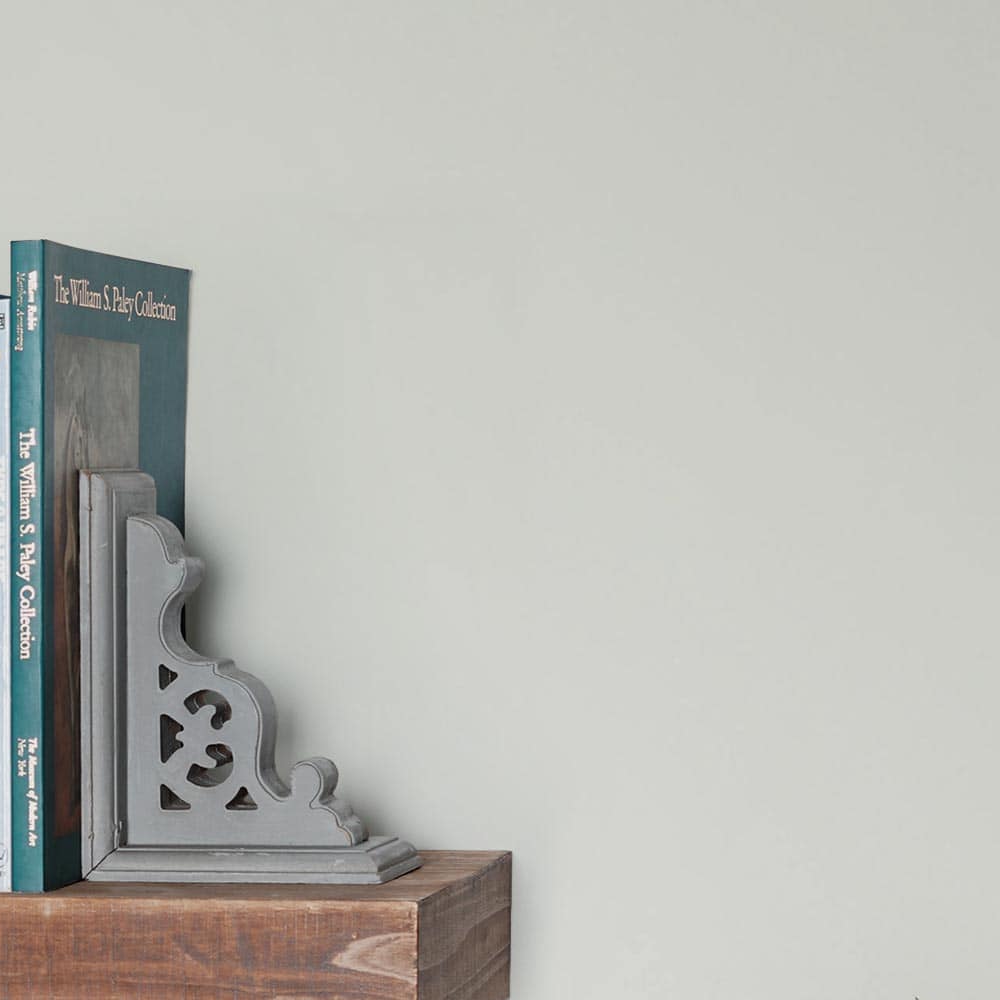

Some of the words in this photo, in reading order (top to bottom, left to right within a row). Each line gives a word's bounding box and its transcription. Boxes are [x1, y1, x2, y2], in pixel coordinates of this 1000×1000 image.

[53, 274, 69, 304] The
[69, 278, 102, 309] William
[103, 284, 111, 311] S.
[112, 286, 135, 322] Paley
[135, 291, 176, 321] Collection
[19, 428, 36, 459] The
[19, 462, 36, 520] William
[19, 524, 36, 537] S.
[16, 542, 36, 581] Paley
[19, 585, 36, 660] Collection
[17, 738, 26, 756] New
[28, 737, 38, 754] The
[17, 759, 27, 777] York
[28, 755, 38, 789] Museum
[26, 790, 38, 800] of
[28, 801, 38, 830] Modern
[28, 832, 38, 847] Art
